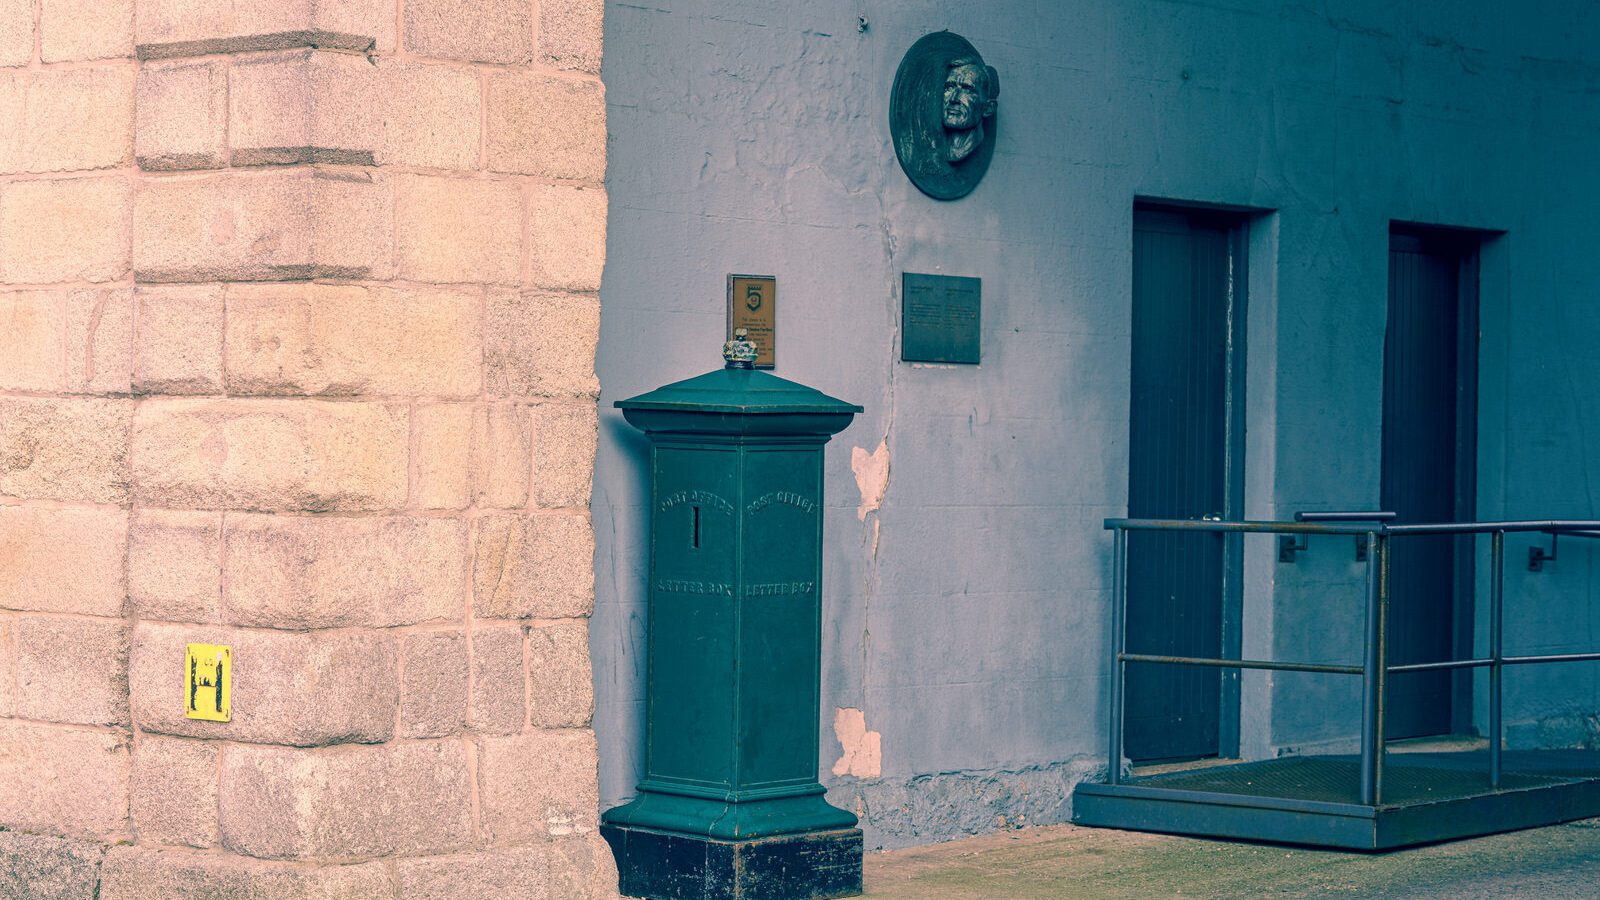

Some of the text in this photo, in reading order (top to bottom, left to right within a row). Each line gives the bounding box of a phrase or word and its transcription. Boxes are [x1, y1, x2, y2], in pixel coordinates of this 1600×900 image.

[746, 490, 815, 516] POST OFFICE
[707, 581, 732, 597] BOX
[745, 580, 814, 597] LETTER BOX
